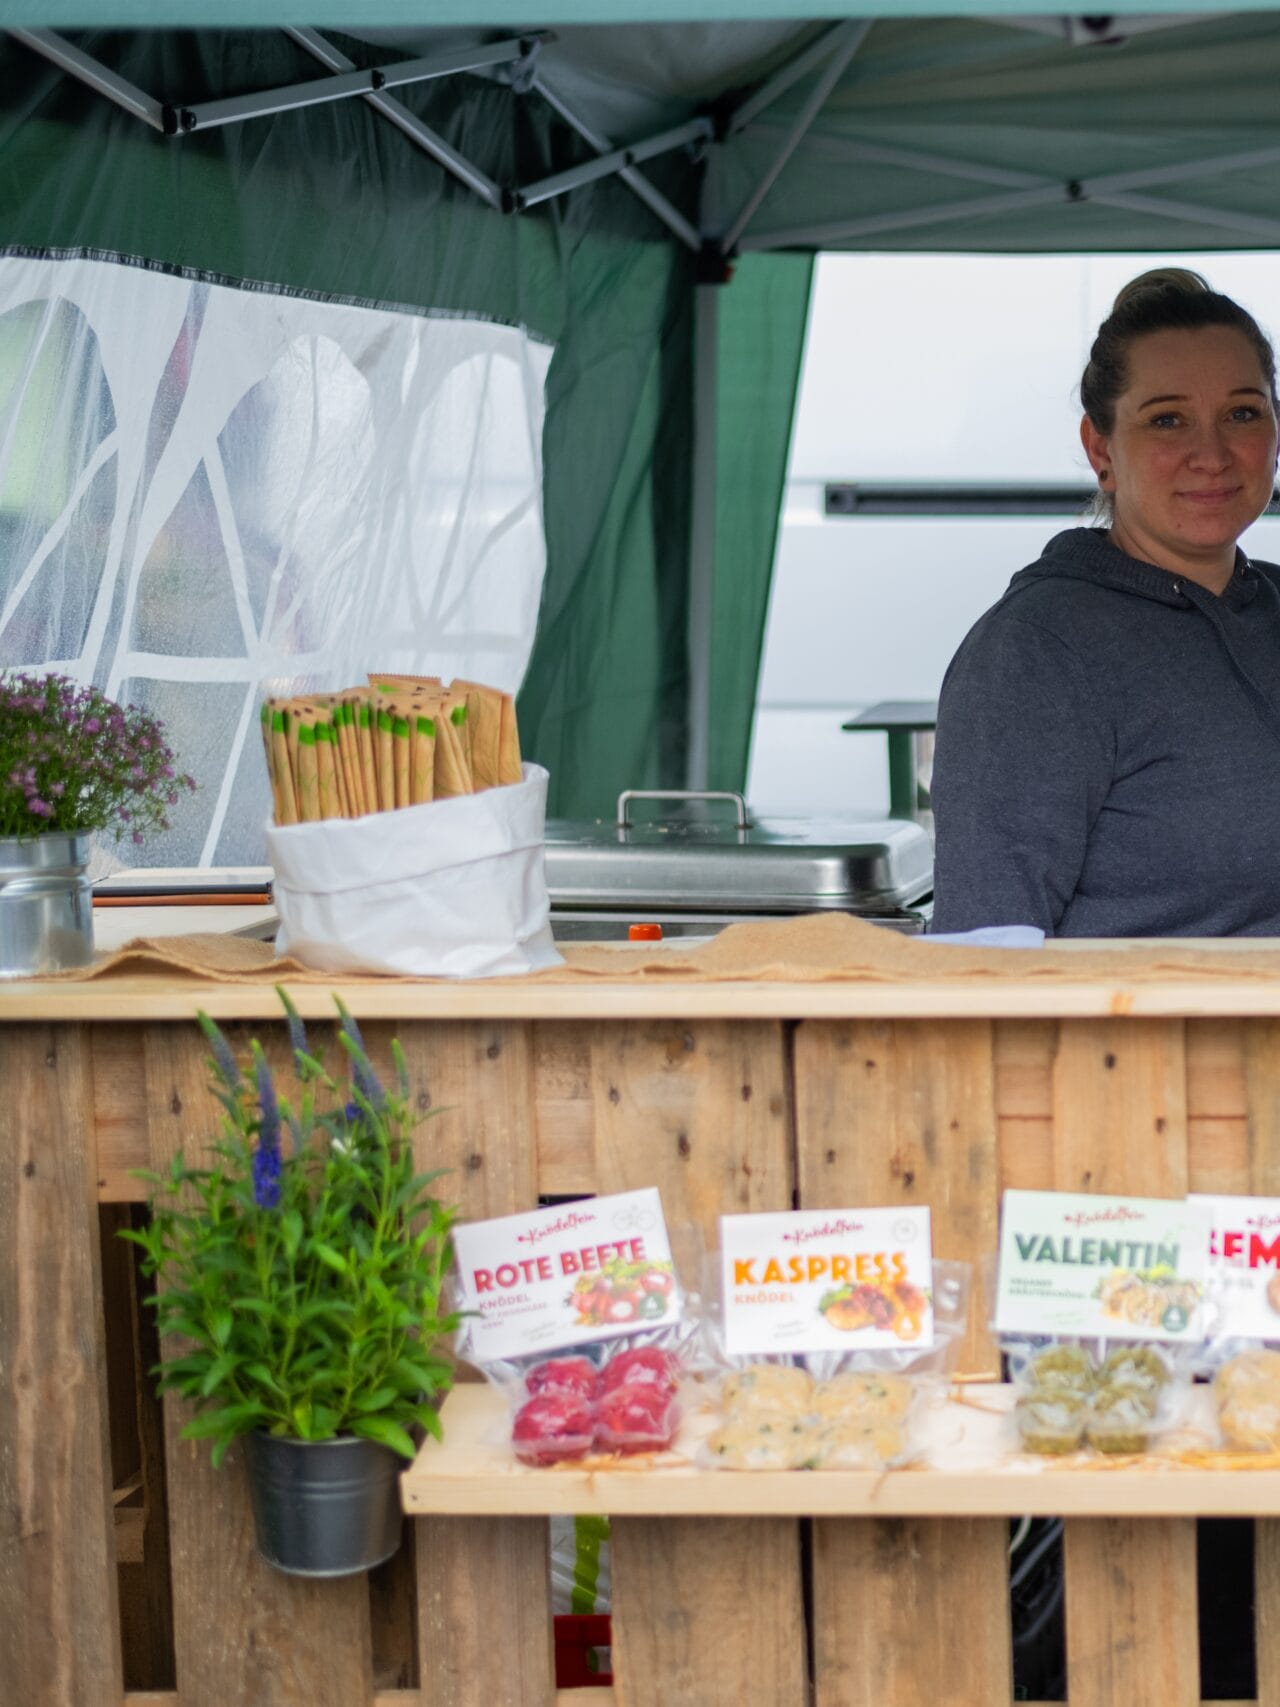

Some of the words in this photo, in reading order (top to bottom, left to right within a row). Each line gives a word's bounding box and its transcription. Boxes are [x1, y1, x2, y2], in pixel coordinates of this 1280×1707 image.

[733, 1250, 908, 1285] KASPRESS
[1013, 1232, 1182, 1270] VALENTIN
[473, 1256, 554, 1294] ROTE
[734, 1290, 794, 1305] KNÖDEL
